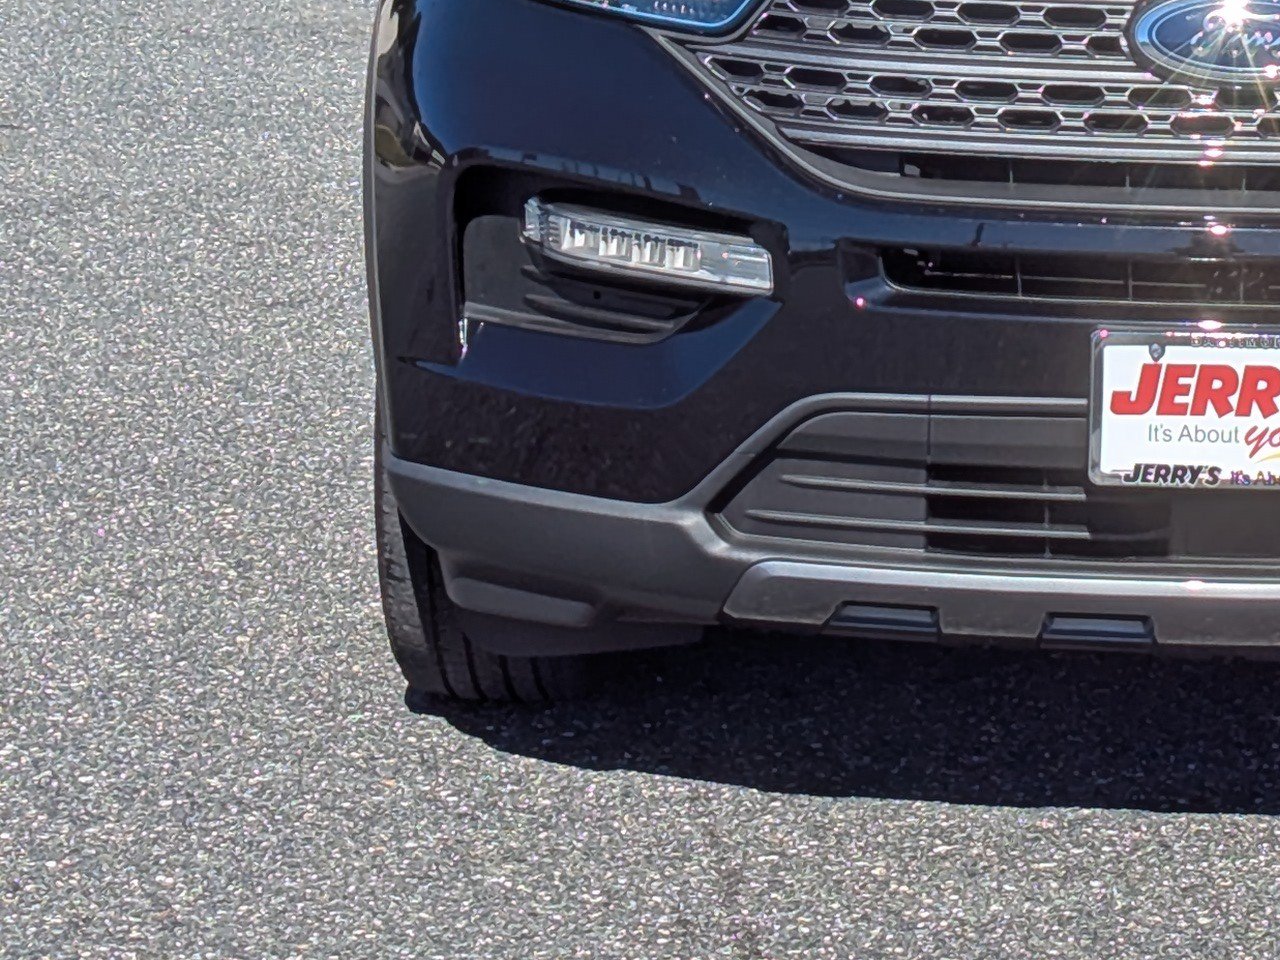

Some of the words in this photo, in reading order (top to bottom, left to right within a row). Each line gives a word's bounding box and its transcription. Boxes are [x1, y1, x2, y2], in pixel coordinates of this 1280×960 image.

[1148, 423, 1173, 443] It's
[1178, 424, 1239, 443] About
[1123, 463, 1222, 486] JERRY'S
[1230, 469, 1251, 486] It's
